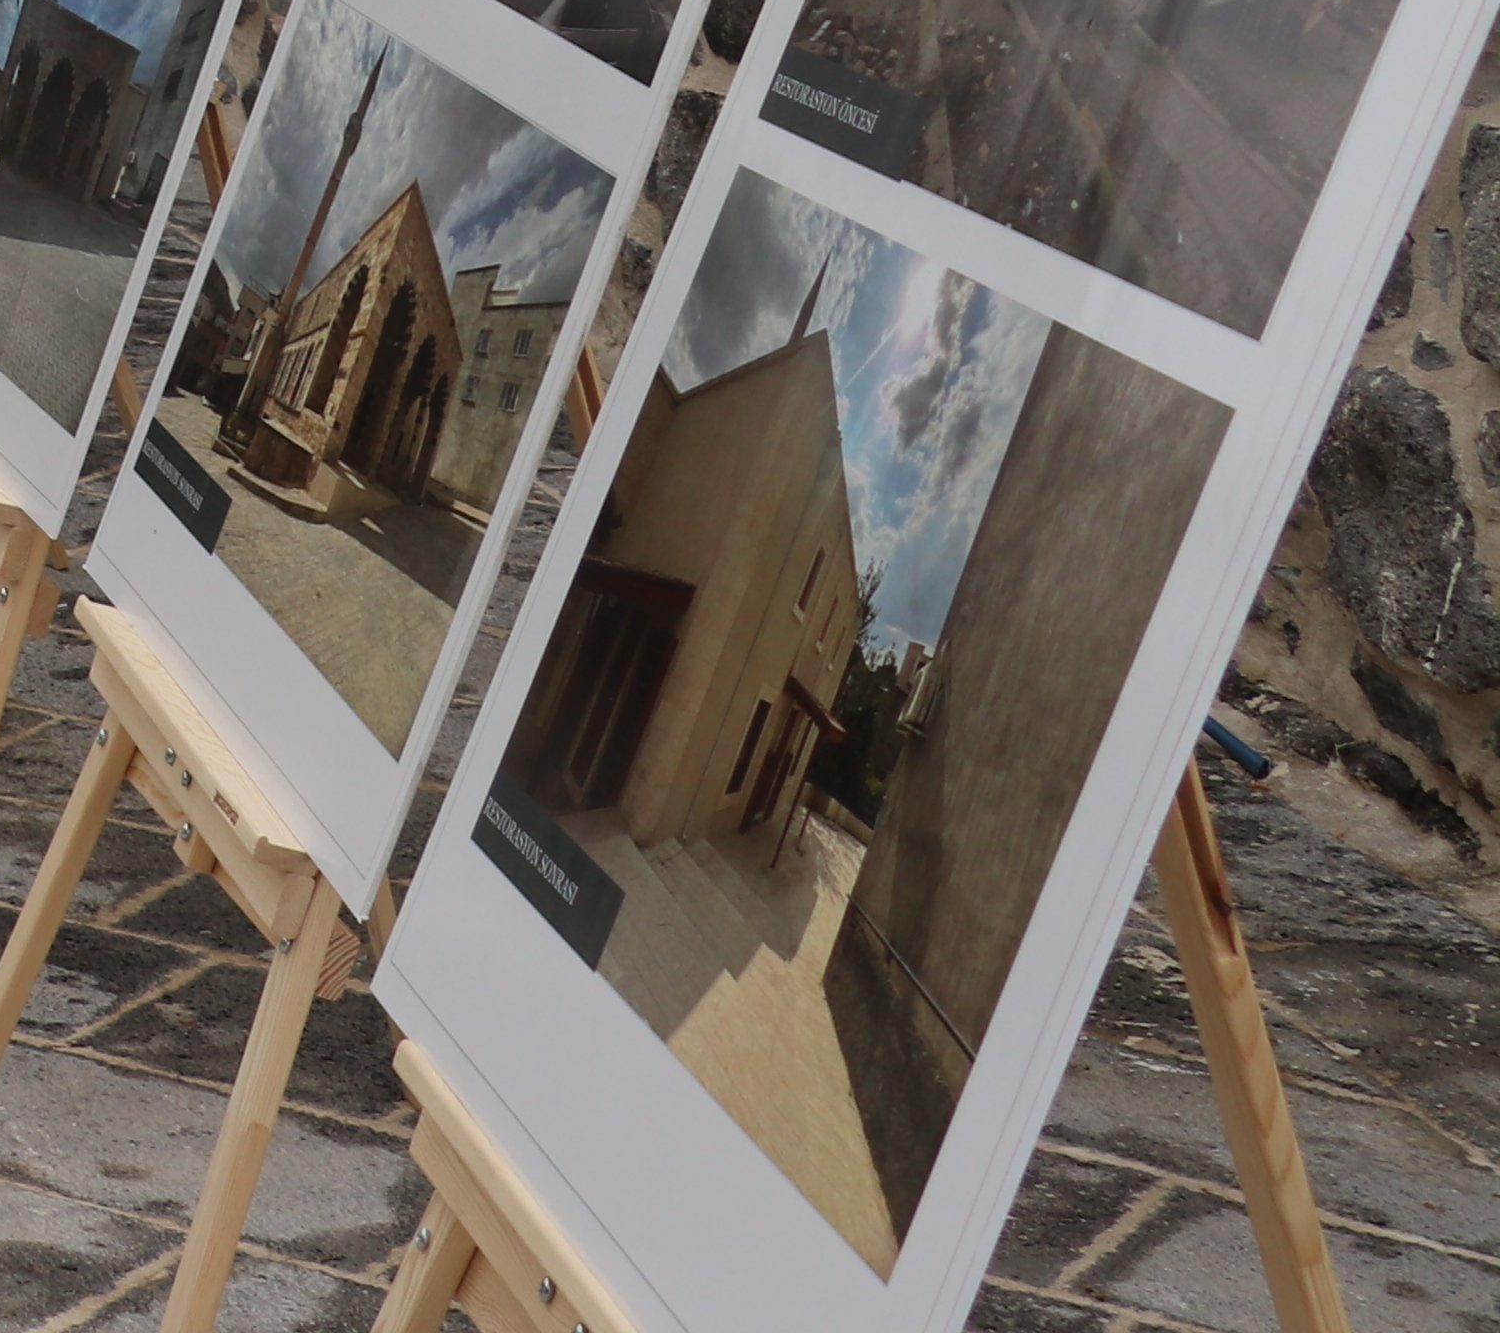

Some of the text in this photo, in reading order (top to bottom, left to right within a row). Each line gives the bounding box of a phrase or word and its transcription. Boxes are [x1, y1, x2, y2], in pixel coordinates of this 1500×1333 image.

[771, 73, 881, 134] RESTORASYON ÖNCESİ
[483, 795, 579, 906] RESTORASYON SONRASI
